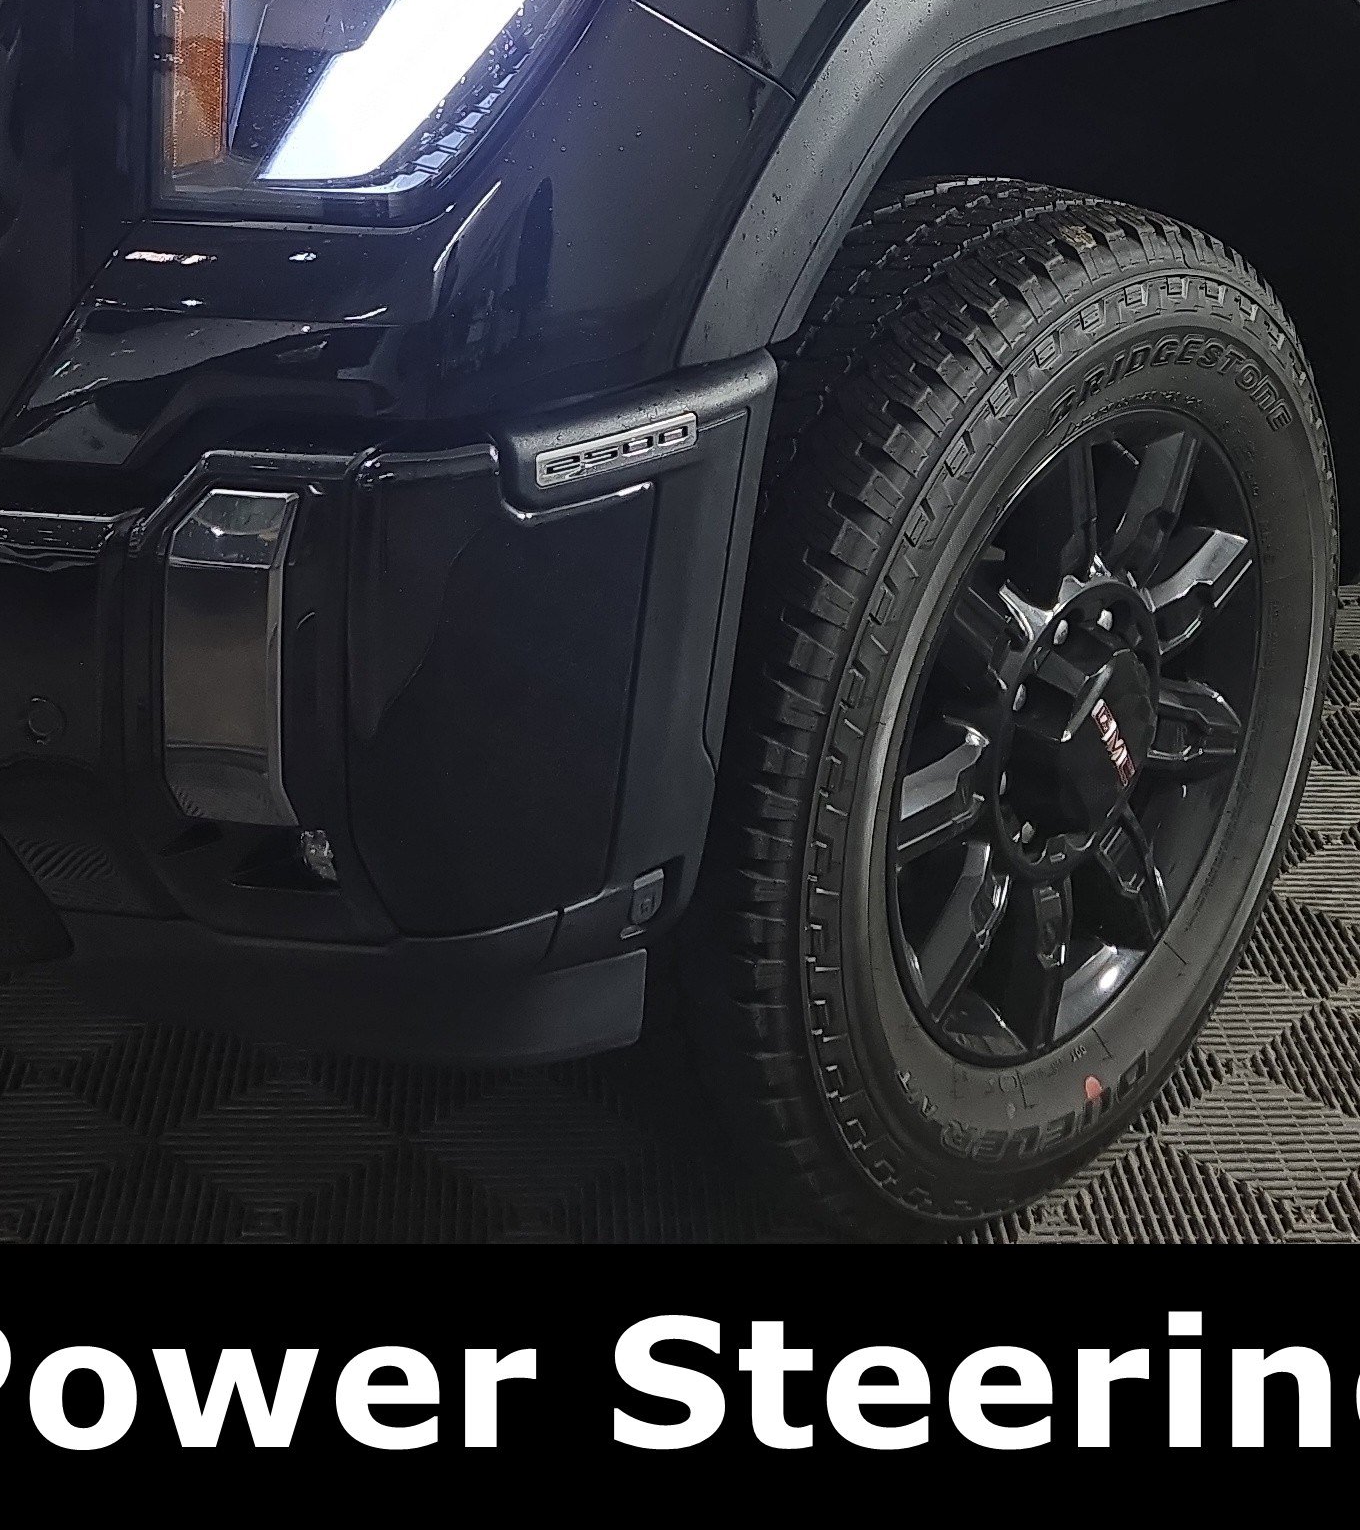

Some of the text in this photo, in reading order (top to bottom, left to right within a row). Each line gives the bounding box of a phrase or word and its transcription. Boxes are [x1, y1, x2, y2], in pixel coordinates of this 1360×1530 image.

[1045, 333, 1292, 438] BRIDGESTONE
[543, 425, 690, 478] 2500
[1090, 697, 1137, 788] GMC
